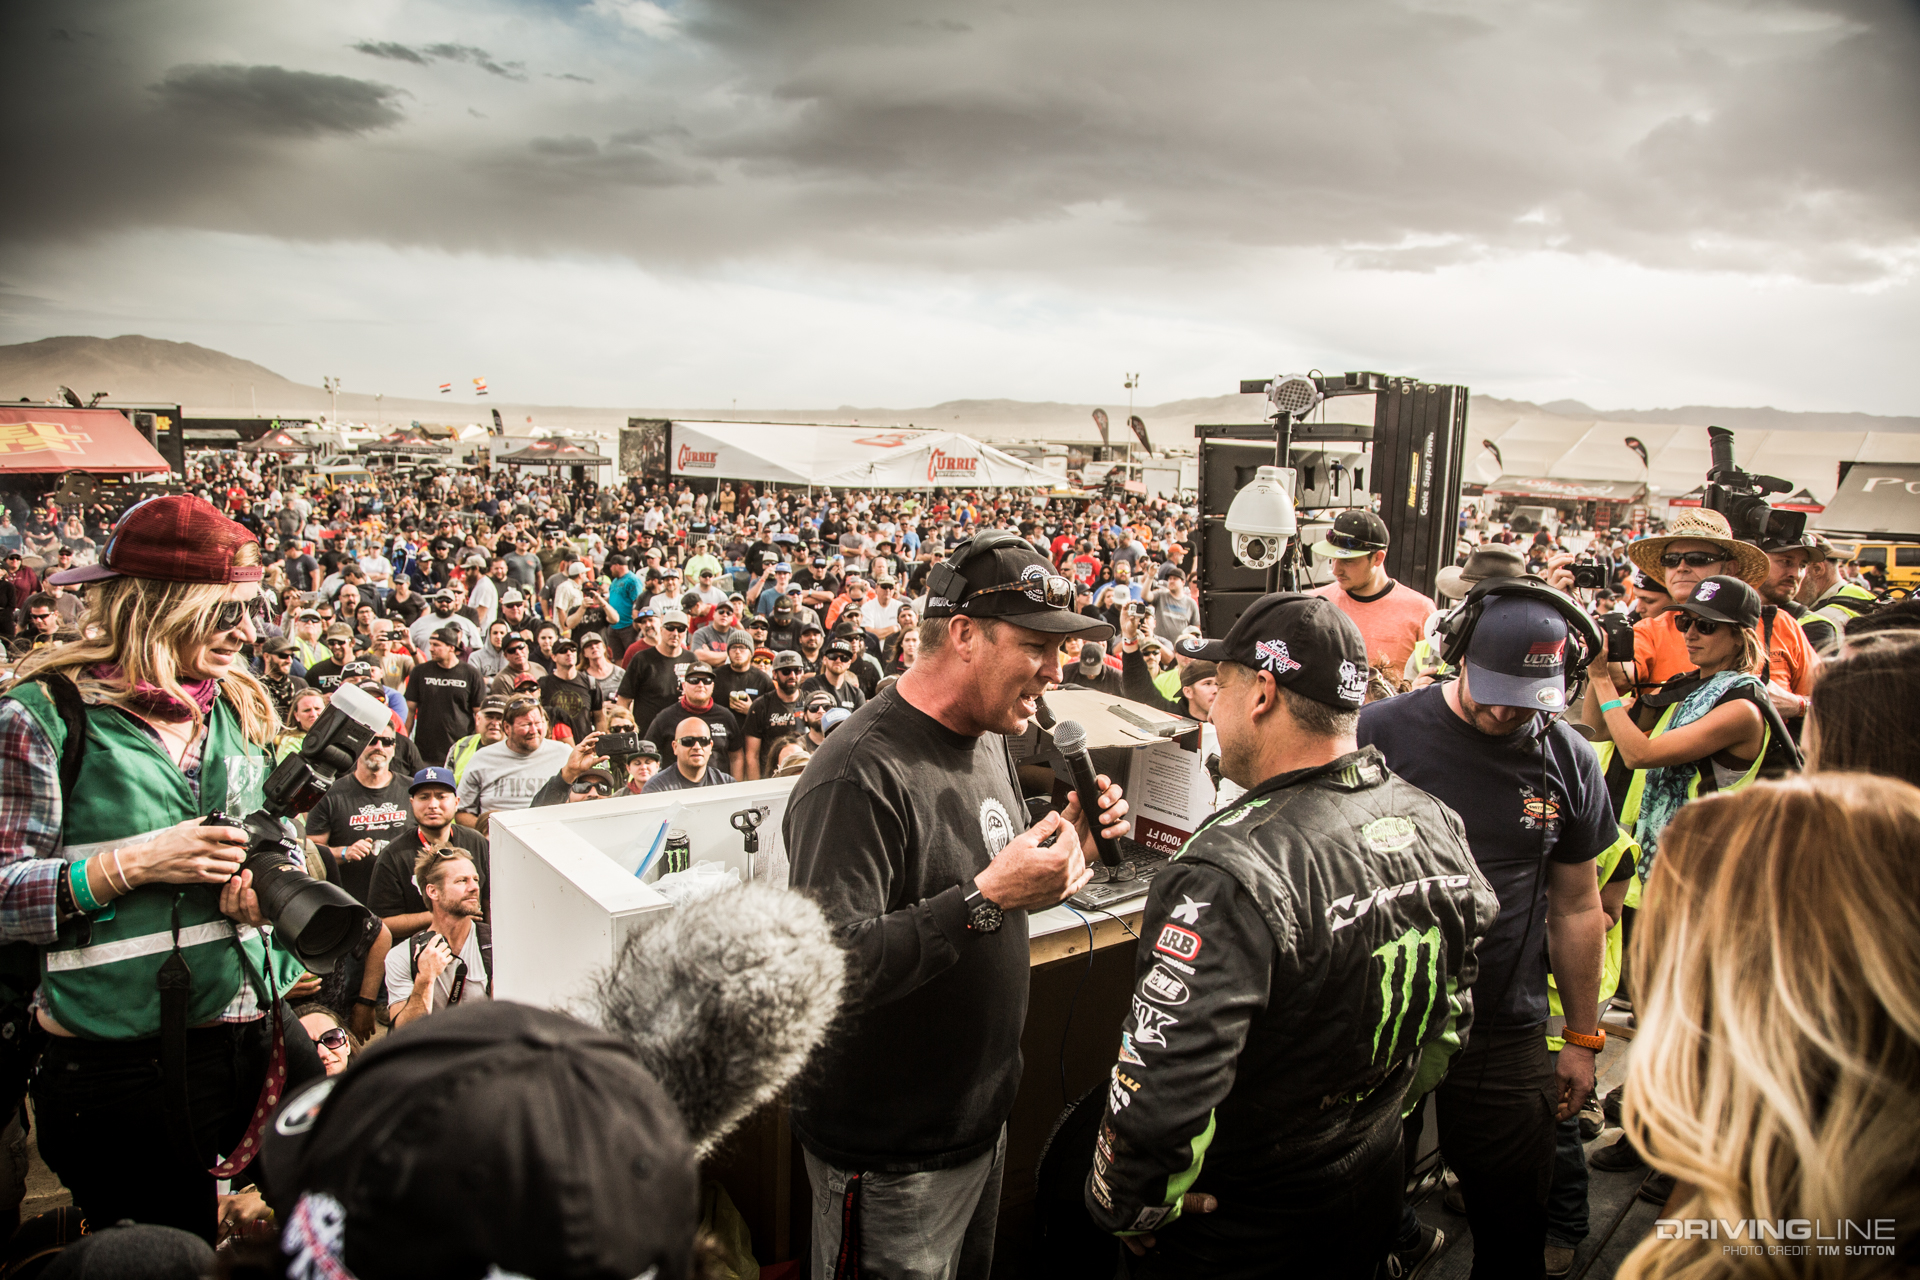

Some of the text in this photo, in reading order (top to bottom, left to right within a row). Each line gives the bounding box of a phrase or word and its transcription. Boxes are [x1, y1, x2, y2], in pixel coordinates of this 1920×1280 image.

[678, 443, 718, 471] CURRIE
[927, 448, 978, 482] CURRIE
[1423, 460, 1433, 488] Super
[1420, 490, 1430, 516] Genie
[424, 677, 467, 688] TAYLORED
[426, 768, 437, 779] LA
[349, 810, 407, 826] HOLLISTER
[280, 838, 297, 850] Nikon
[1146, 827, 1182, 847] 1000 FT
[1151, 841, 1178, 856] ategory
[1159, 928, 1196, 956] ARB
[451, 980, 462, 1003] Canon
[1132, 993, 1179, 1043] FOX
